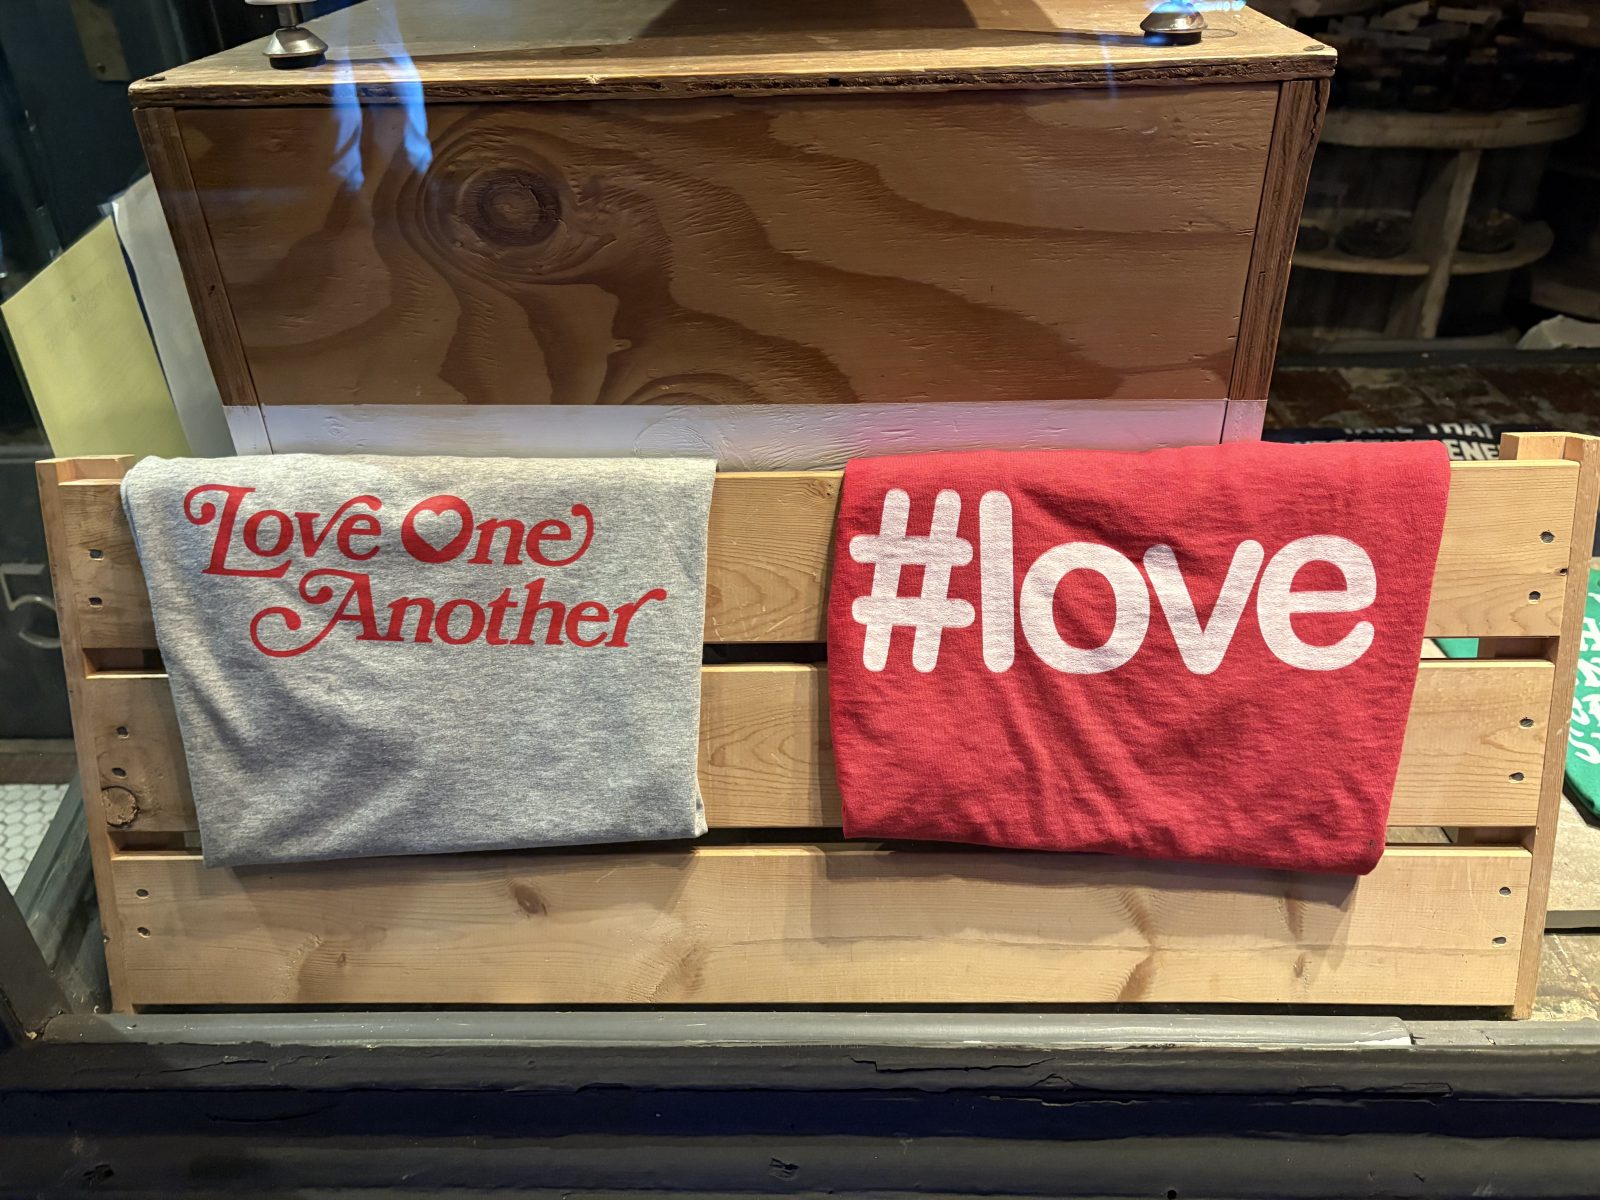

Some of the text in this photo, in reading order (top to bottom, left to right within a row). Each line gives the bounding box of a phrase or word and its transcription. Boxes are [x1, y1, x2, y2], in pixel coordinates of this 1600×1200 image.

[1442, 439, 1500, 461] ENE
[184, 483, 595, 578] Love One
[249, 567, 668, 658] Another
[848, 487, 1378, 675] #love
